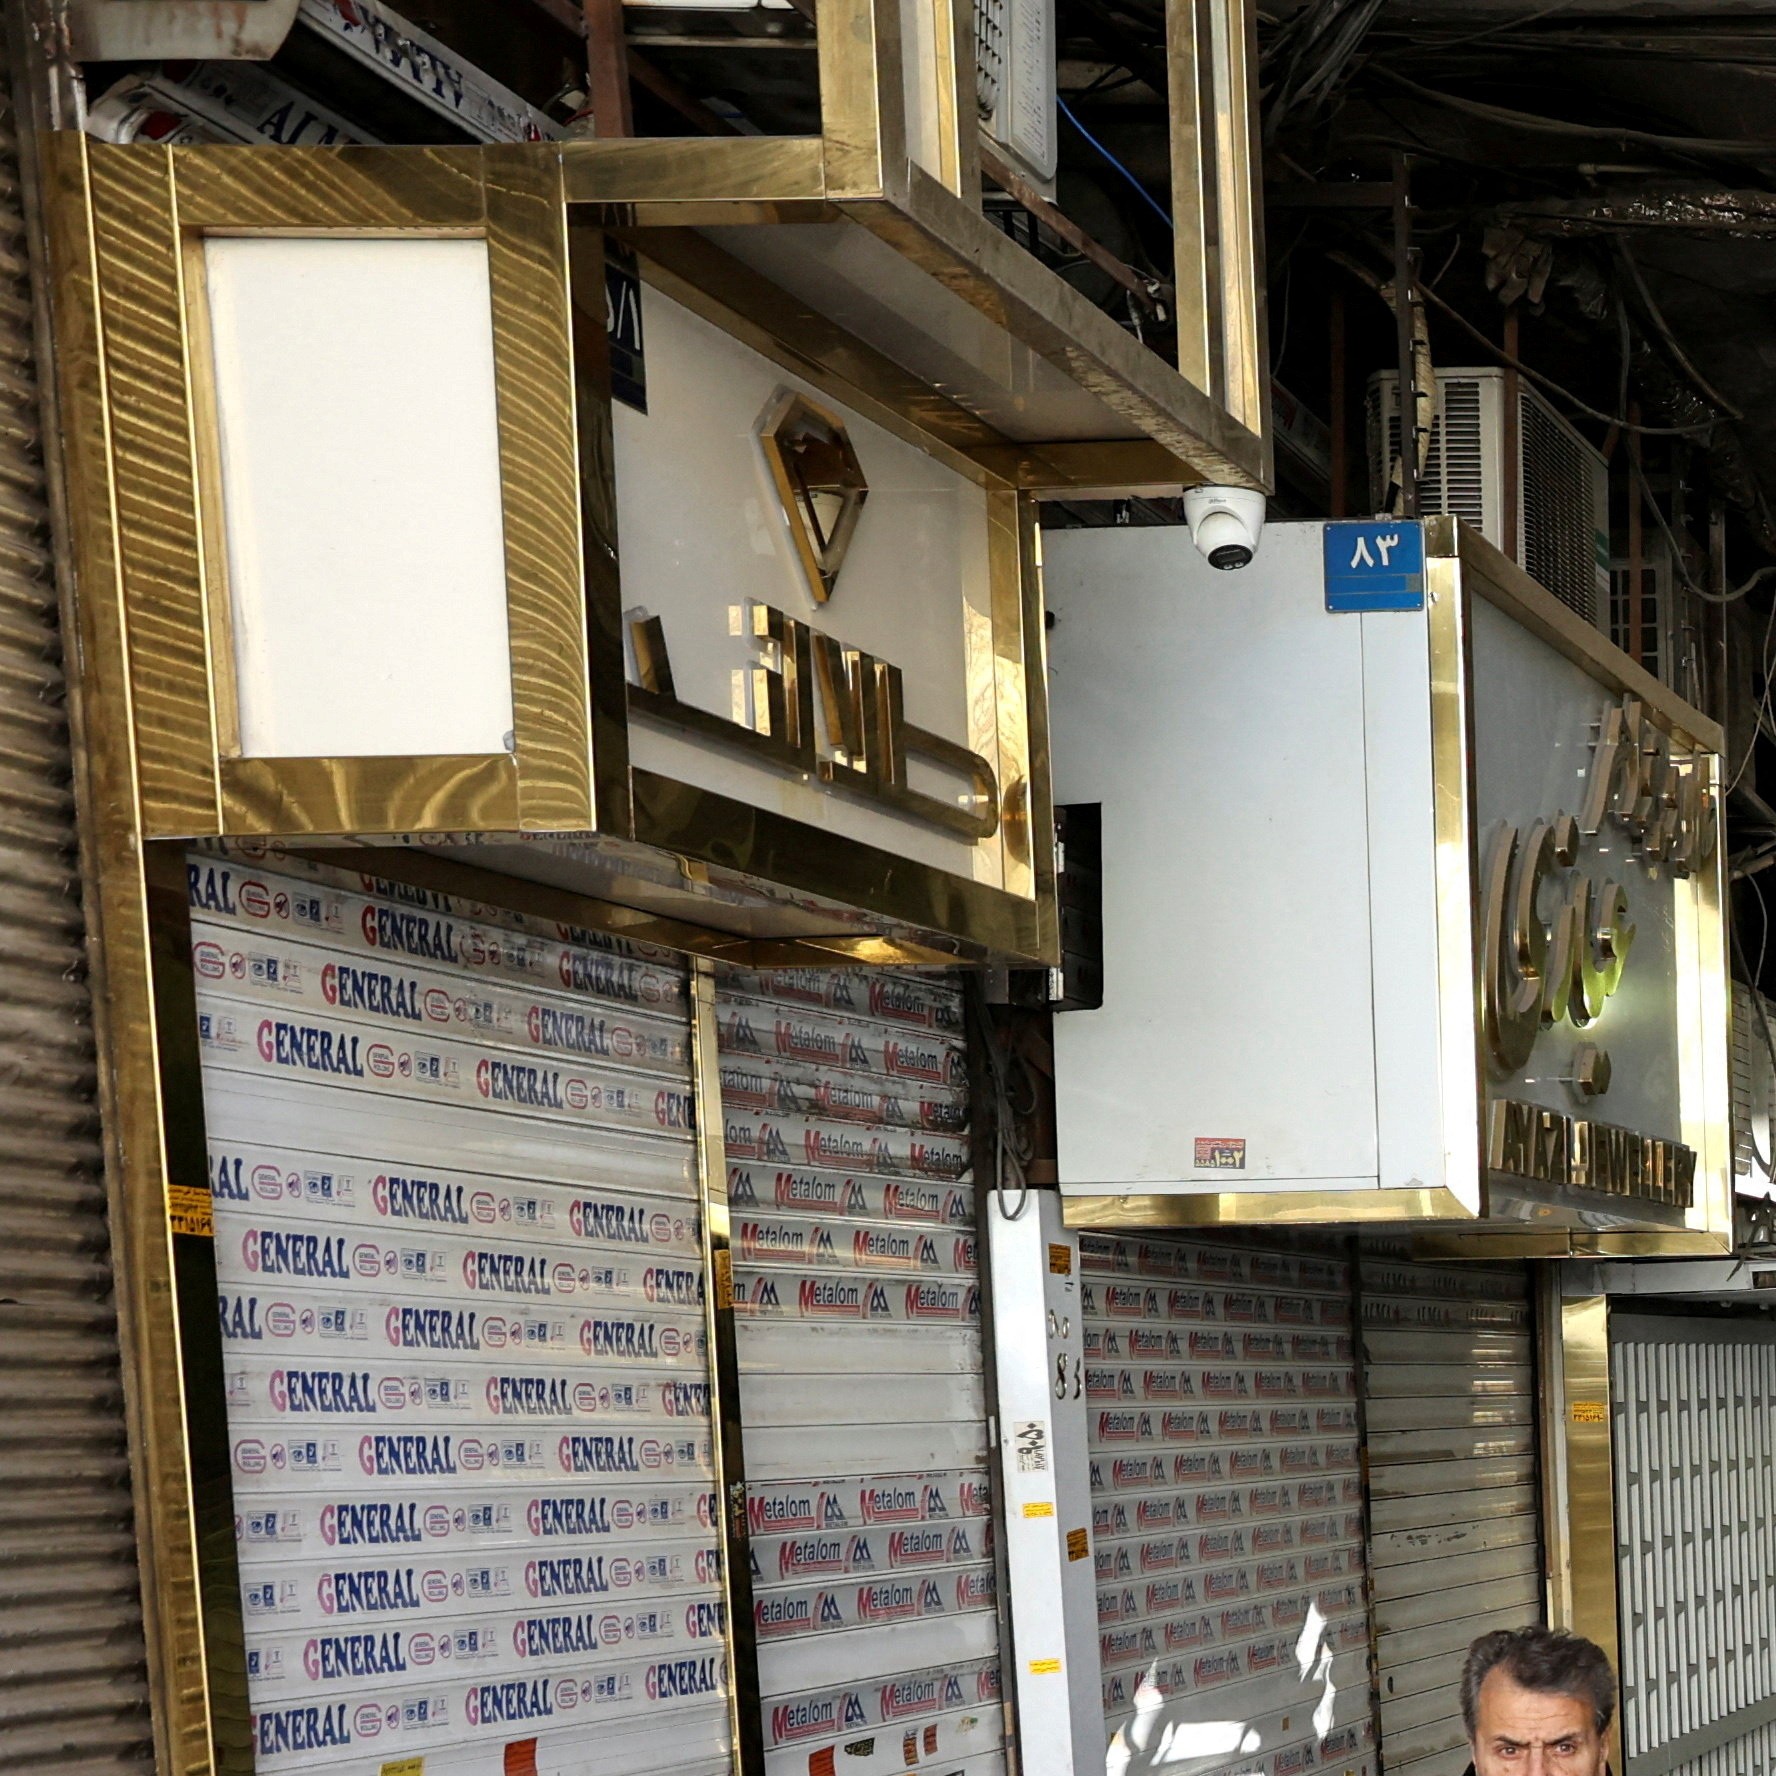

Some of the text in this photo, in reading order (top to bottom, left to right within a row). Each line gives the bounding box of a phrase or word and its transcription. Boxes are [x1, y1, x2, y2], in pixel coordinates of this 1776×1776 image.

[1351, 533, 1399, 569] ۸۳
[361, 905, 458, 963] GENERAL
[321, 963, 421, 1021] GENERAL
[558, 952, 639, 1001] GENERAL
[869, 981, 924, 1016] Metalom
[257, 1020, 364, 1077] GENERAL
[528, 1007, 608, 1057] GENERAL
[775, 1020, 835, 1053] Metalom
[884, 1040, 938, 1075] Metalom
[476, 1059, 563, 1109] GENERAL
[815, 1081, 873, 1110] Metalom
[805, 1128, 863, 1166] Metalom
[910, 1142, 962, 1173] Metalom
[372, 1175, 468, 1224] GENERAL
[775, 1172, 835, 1209] Metalom
[884, 1183, 938, 1218] Metalom
[569, 1200, 648, 1243] GENERAL
[741, 1223, 803, 1261] Metalom
[242, 1229, 349, 1279] GENERAL
[854, 1230, 909, 1267] Metalom
[463, 1249, 550, 1296] GENERAL
[799, 1280, 858, 1319] Metalom
[905, 1283, 958, 1319] Metalom
[385, 1306, 479, 1350] GENERAL
[579, 1319, 657, 1359] GENERAL
[269, 1370, 376, 1413] GENERAL
[485, 1377, 572, 1415] GENERAL
[359, 1434, 456, 1476] GENERAL
[558, 1435, 639, 1474] GENERAL
[319, 1502, 421, 1545] GENERAL
[526, 1496, 610, 1537] GENERAL
[749, 1495, 810, 1536] Metalom
[860, 1488, 915, 1525] Metalom
[779, 1538, 840, 1580] Metalom
[889, 1530, 942, 1568] Metalom
[318, 1567, 420, 1614] GENERAL
[524, 1556, 609, 1598] GENERAL
[857, 1584, 912, 1620] Metalom
[304, 1632, 407, 1680] GENERAL
[513, 1614, 597, 1658] GENERAL
[646, 1656, 717, 1698] GENERAL
[465, 1678, 553, 1727] GENERAL
[881, 1680, 934, 1723] Metalom
[772, 1702, 832, 1745] Metalom
